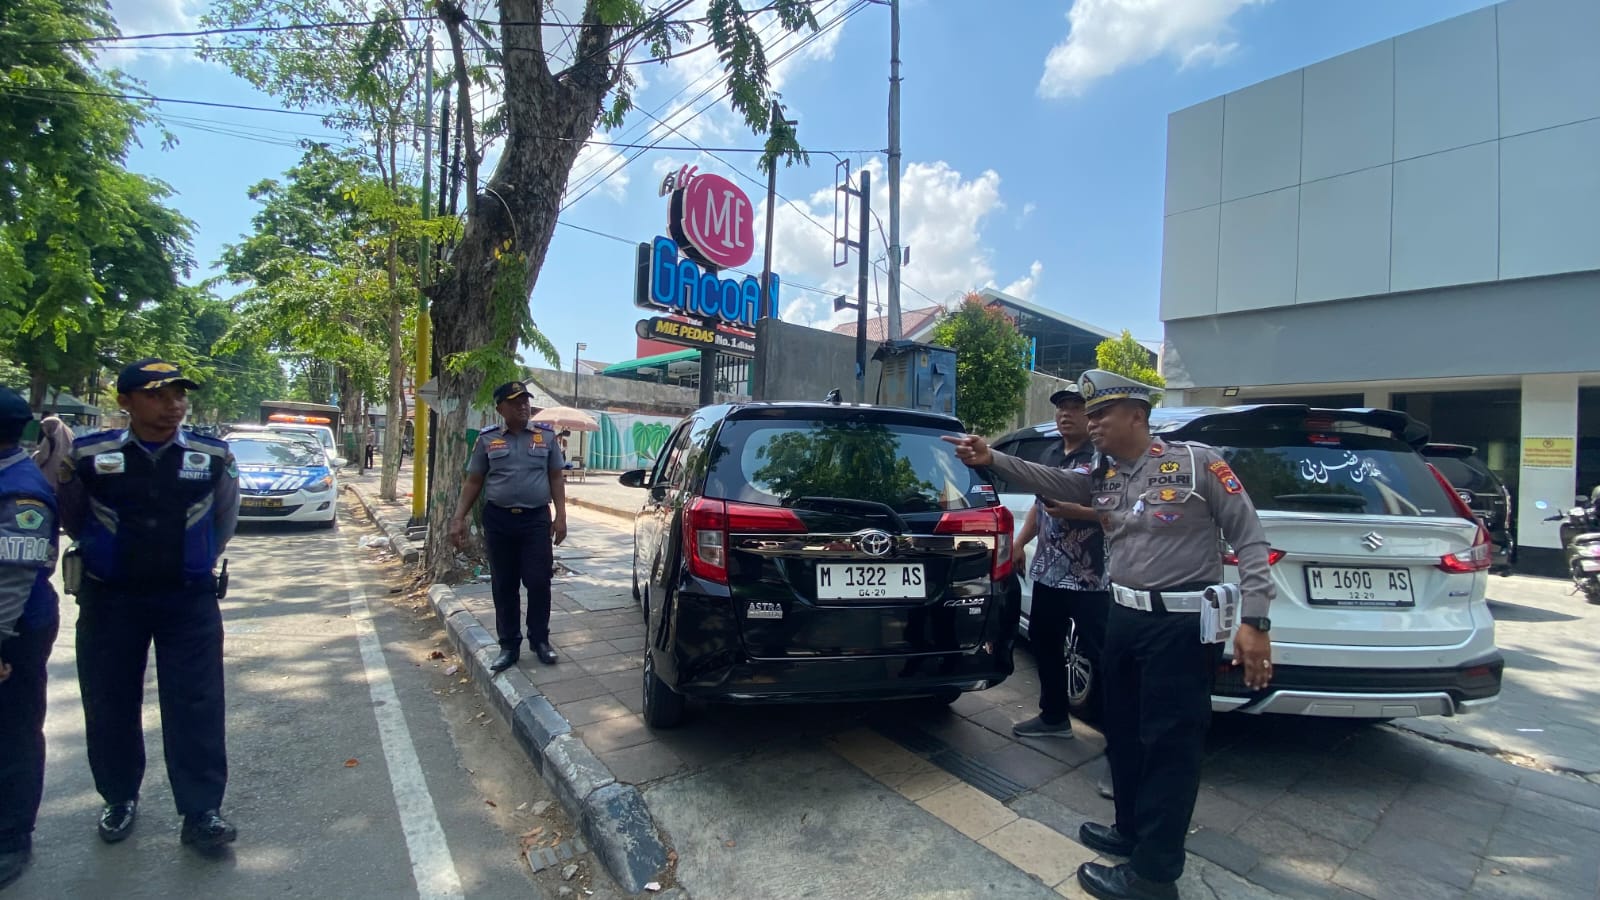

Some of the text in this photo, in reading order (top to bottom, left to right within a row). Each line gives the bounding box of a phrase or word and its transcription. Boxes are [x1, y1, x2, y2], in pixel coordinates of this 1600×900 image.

[656, 320, 679, 335] MIE
[680, 325, 715, 343] PEDAS
[1148, 475, 1190, 486] POLRI
[821, 567, 922, 587] M 1322 AS
[1312, 570, 1408, 590] M 1690 AS
[749, 602, 783, 611] ASTRA
